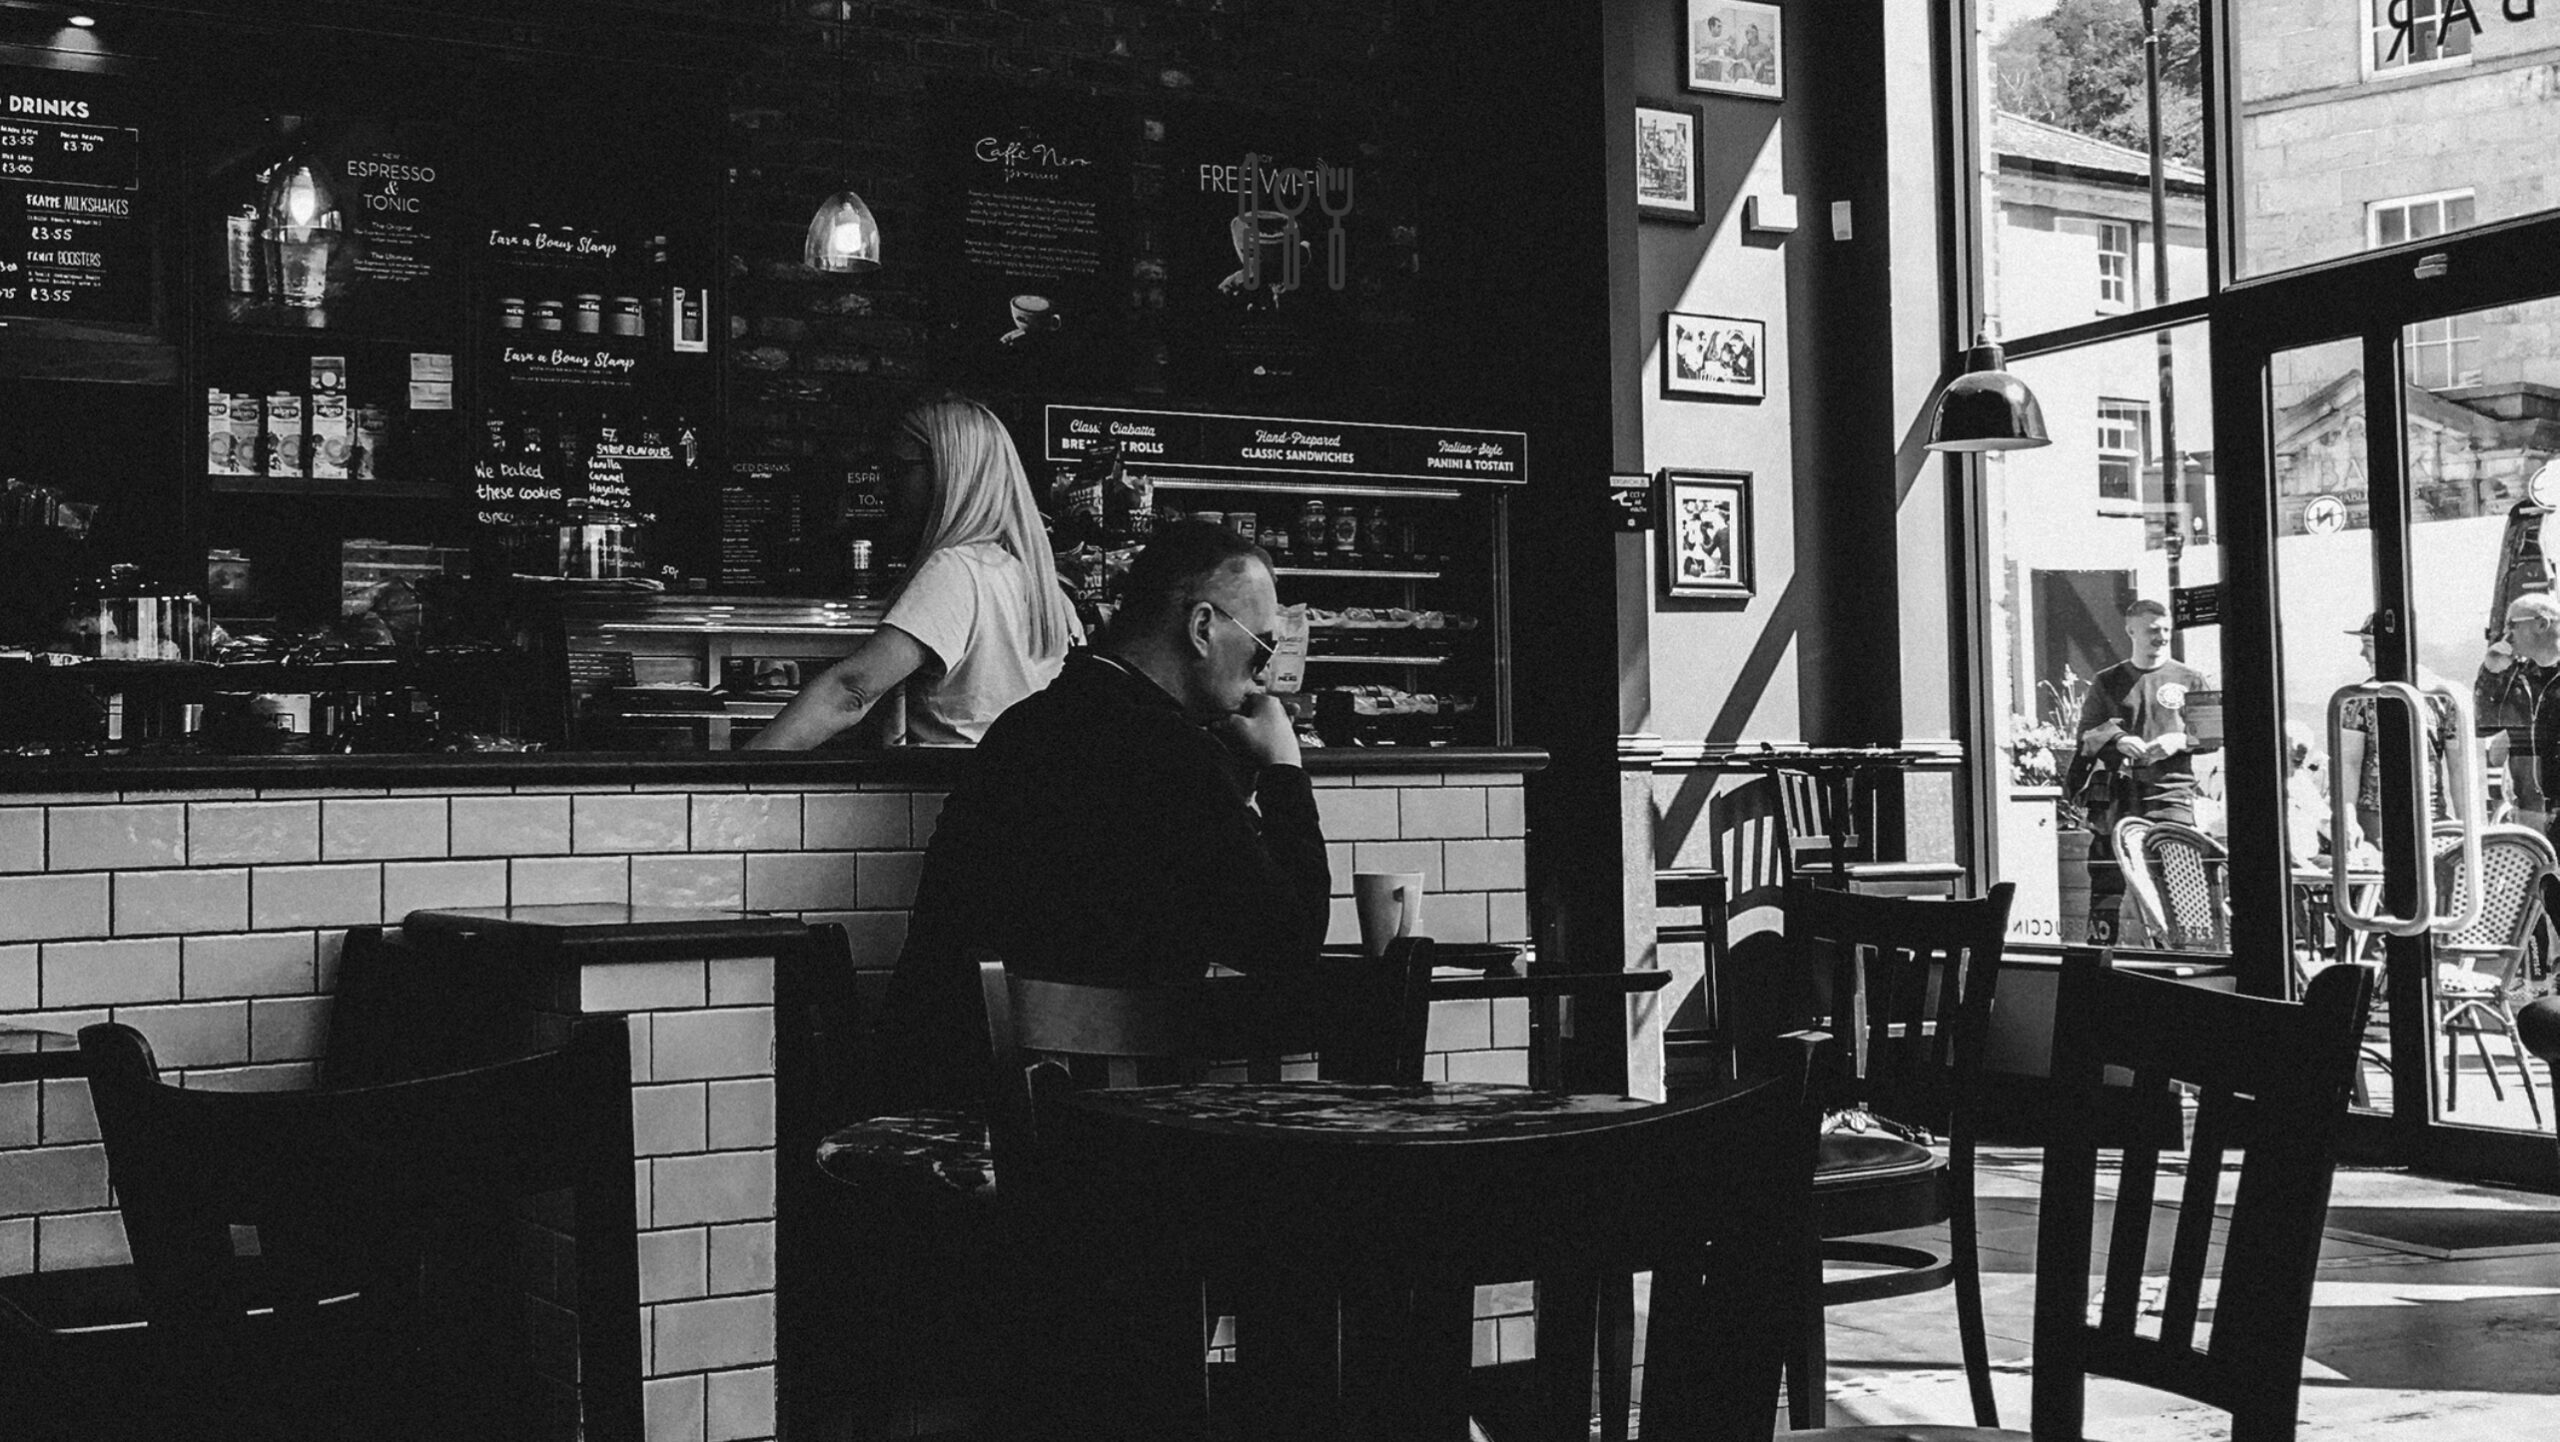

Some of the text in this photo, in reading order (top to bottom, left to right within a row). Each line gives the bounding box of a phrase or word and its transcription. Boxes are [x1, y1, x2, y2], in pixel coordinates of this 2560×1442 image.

[9, 94, 90, 119] DRINKS
[347, 160, 436, 182] ESPRESSO
[384, 181, 399, 195] &
[1200, 164, 1320, 197] FREE WI-FI
[26, 194, 129, 215] FRAPPE MILKSHAKES
[363, 194, 420, 213] TONIC
[489, 229, 617, 258] Earn a Bonus Stamp
[58, 251, 101, 267] BOOSTERS
[503, 348, 536, 362] Earn
[537, 353, 547, 363] a
[552, 349, 591, 367] Bonus
[593, 352, 635, 373] Stamp
[1110, 421, 1157, 437] Ciabatta
[1129, 441, 1164, 454] ROLLS
[1255, 429, 1342, 448] Hand-Prepared
[1241, 448, 1355, 464] CLASSIC SANDWICHES
[1437, 440, 1504, 458] Italian-Style
[474, 460, 495, 478] We
[587, 456, 622, 470] Vanilla
[1427, 457, 1514, 472] PANINI & TOSTATI
[588, 471, 625, 484] Caramel
[476, 483, 562, 501] these cookies
[589, 482, 631, 497] Hazelnut
